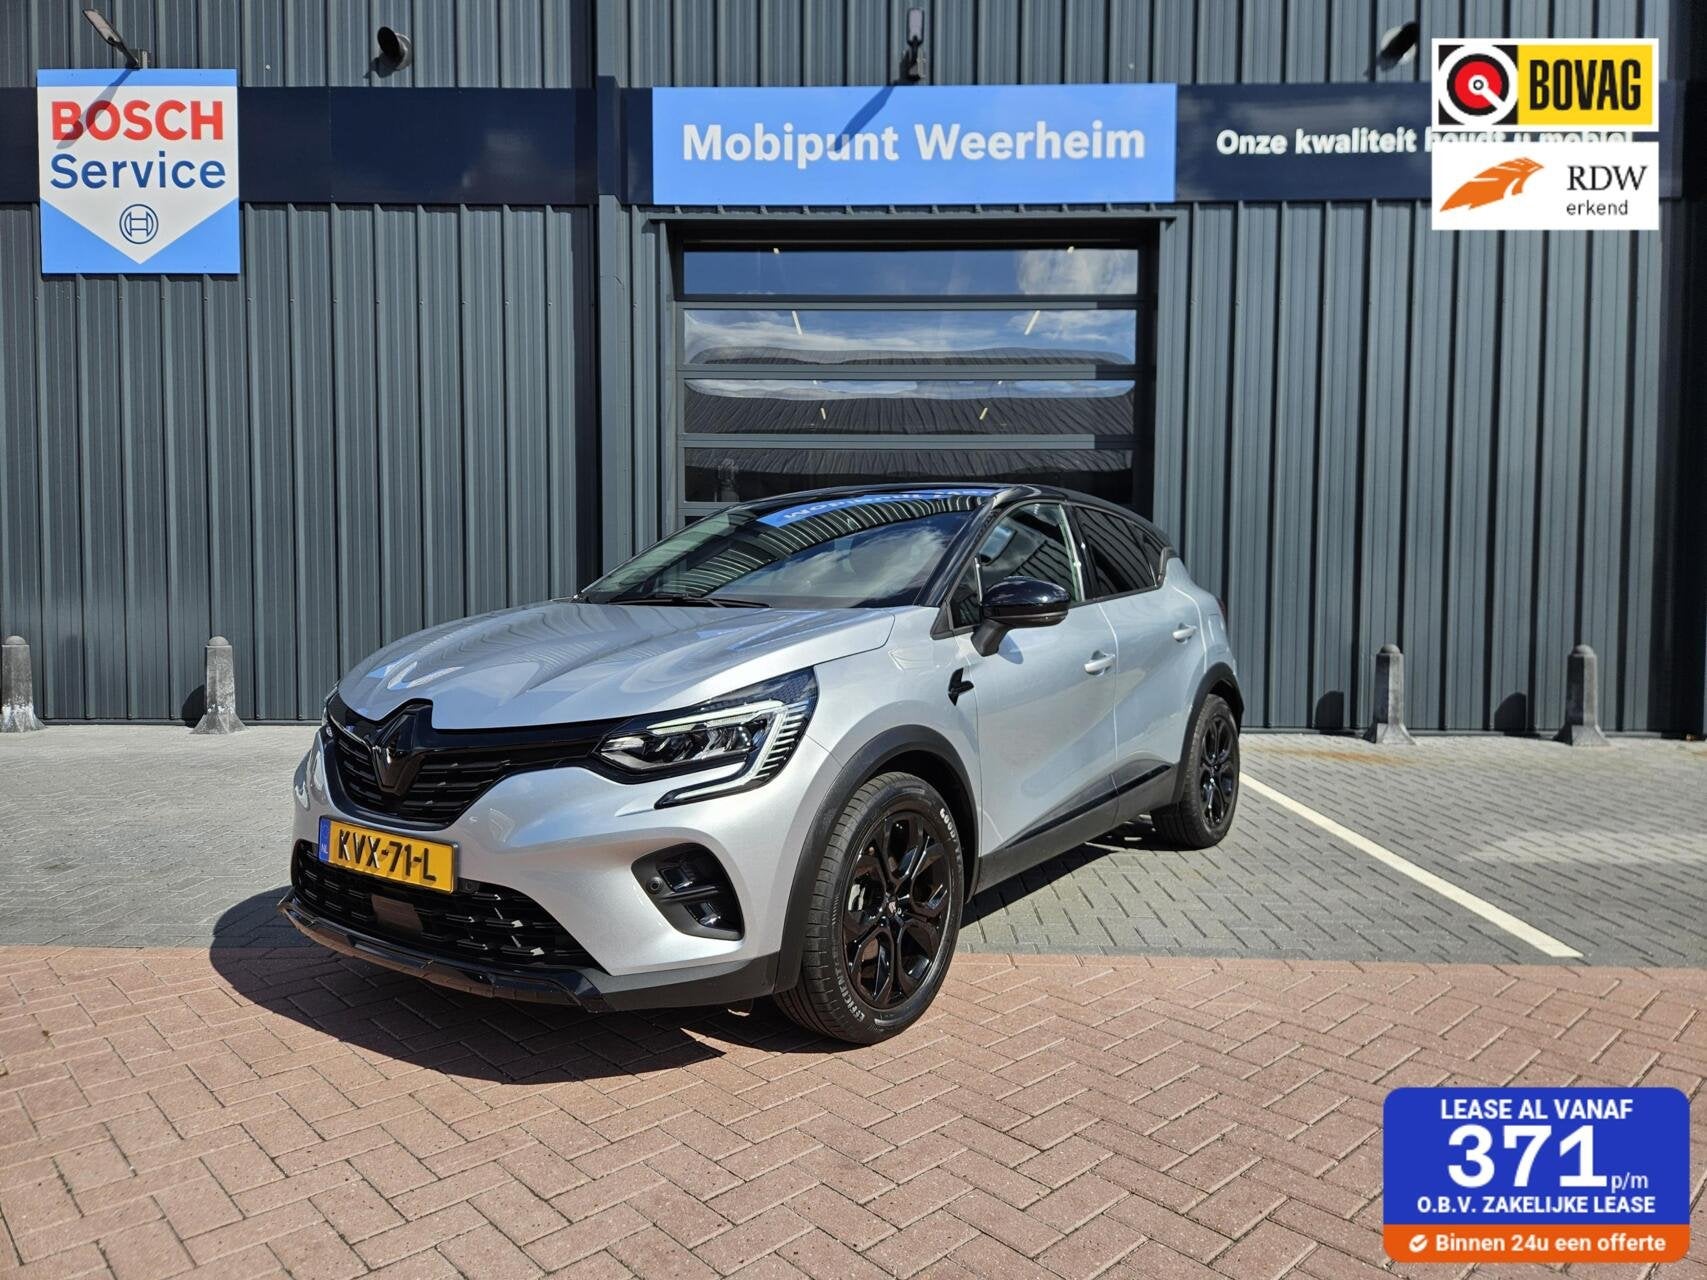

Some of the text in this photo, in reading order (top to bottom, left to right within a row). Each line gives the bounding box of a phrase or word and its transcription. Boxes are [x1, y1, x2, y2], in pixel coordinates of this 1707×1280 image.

[52, 100, 223, 140] BOSCH
[1216, 129, 1287, 154] Onze
[1295, 126, 1417, 154] kwaliteit
[683, 120, 1145, 170] Mobipunt Weerheim
[51, 151, 225, 189] Service
[338, 829, 437, 882] KVX-71-L
